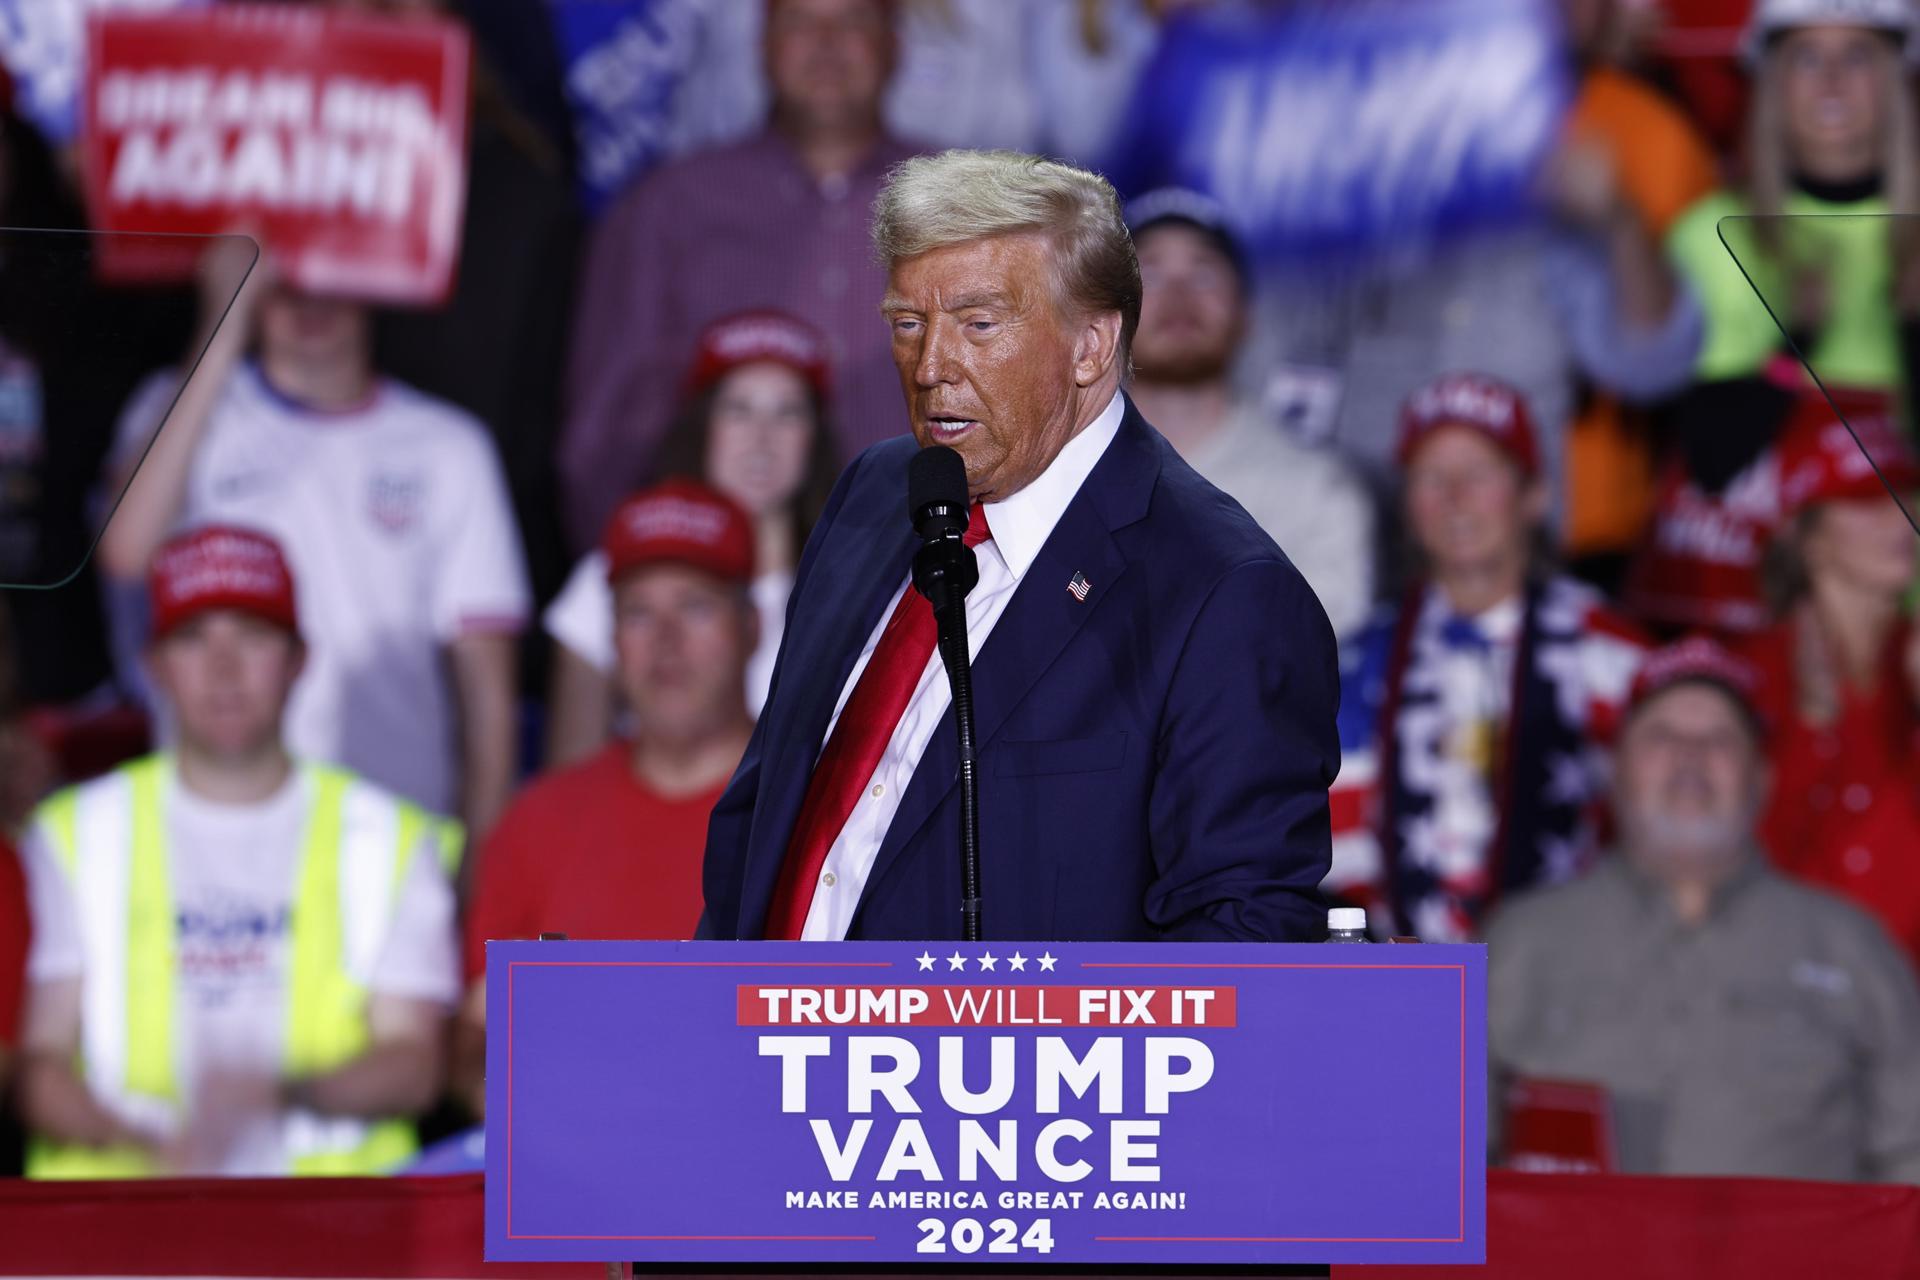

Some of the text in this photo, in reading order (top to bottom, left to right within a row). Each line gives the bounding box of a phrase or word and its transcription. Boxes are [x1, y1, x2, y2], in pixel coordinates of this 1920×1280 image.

[759, 989, 1215, 1024] TRUMP WILL FIX IT
[759, 1036, 1214, 1114] TRUMP
[809, 1118, 1160, 1183] VANCE
[786, 1191, 1186, 1210] MAKE AMERICA GREAT AGAIN!
[917, 1217, 1055, 1254] 2024
